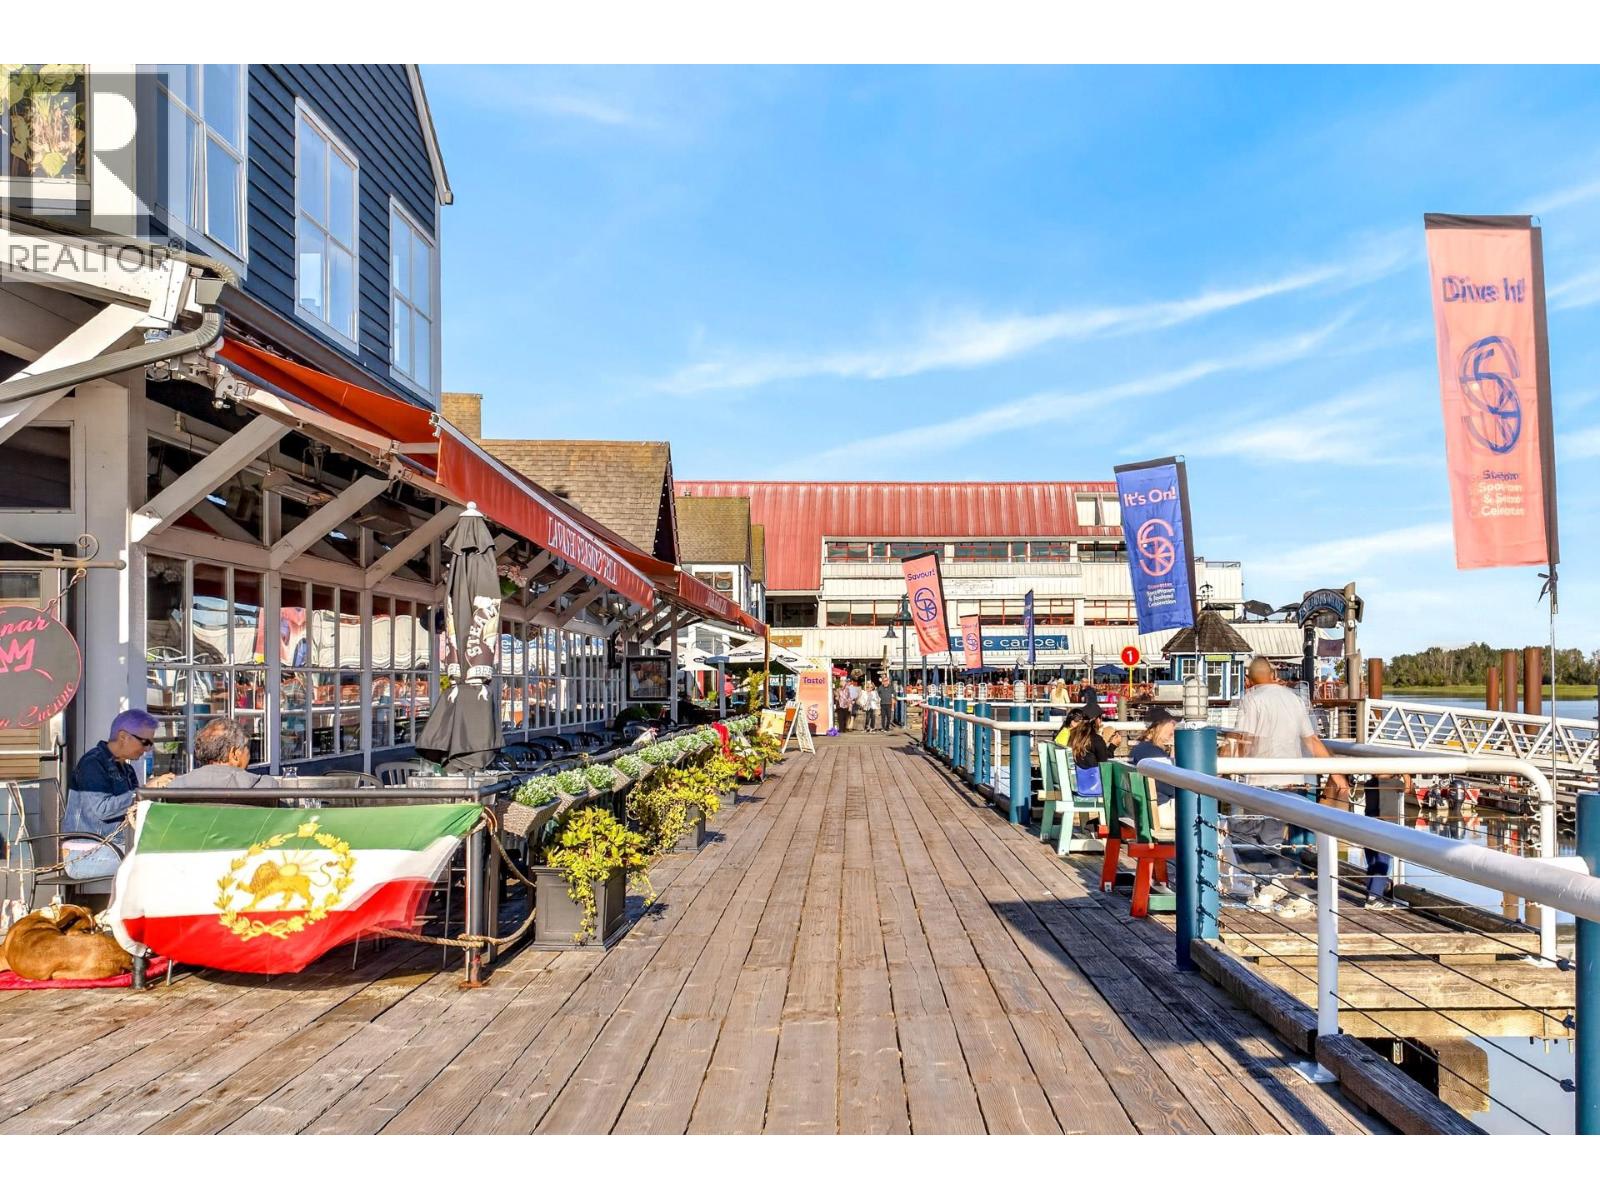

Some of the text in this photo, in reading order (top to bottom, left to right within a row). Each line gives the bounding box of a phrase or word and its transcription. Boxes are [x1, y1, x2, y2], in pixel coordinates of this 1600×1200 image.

[1124, 486, 1177, 507] It's On!
[907, 569, 936, 581] Savour!
[955, 637, 993, 648] be
[1126, 650, 1134, 663] 1
